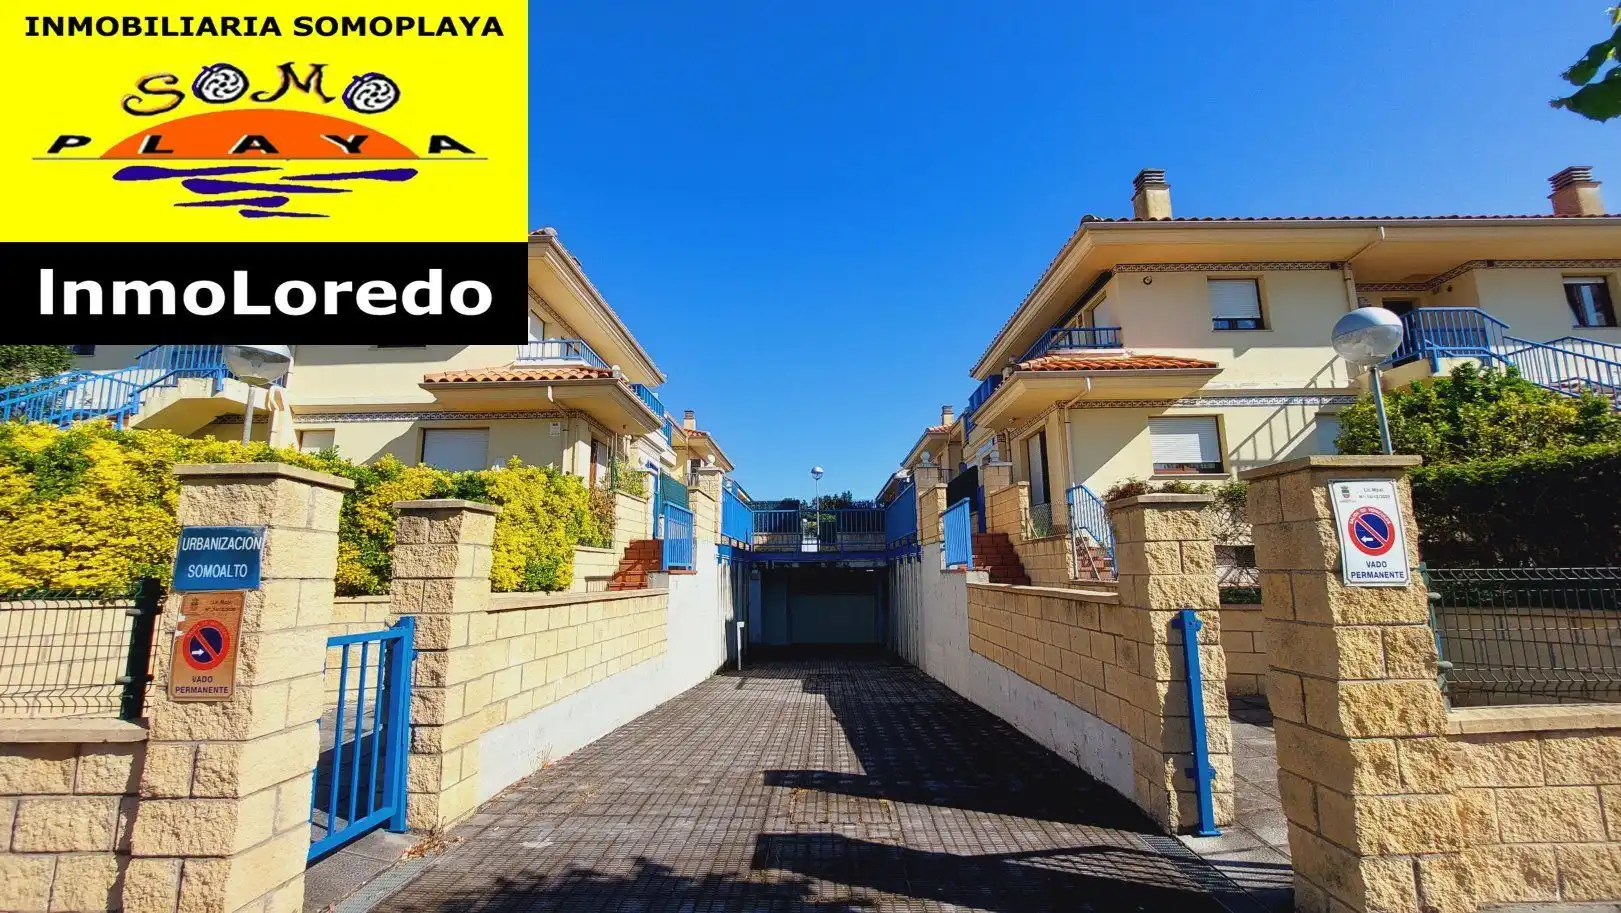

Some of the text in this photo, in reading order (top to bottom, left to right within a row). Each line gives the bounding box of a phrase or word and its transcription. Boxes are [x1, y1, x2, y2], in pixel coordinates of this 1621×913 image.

[182, 536, 262, 551] URBANIZACION
[1366, 560, 1388, 568] VADO
[187, 563, 248, 578] SOMOALTO
[1351, 571, 1404, 579] PERMANENTE
[192, 675, 214, 683] VADO
[175, 686, 229, 694] PERMANENTE
